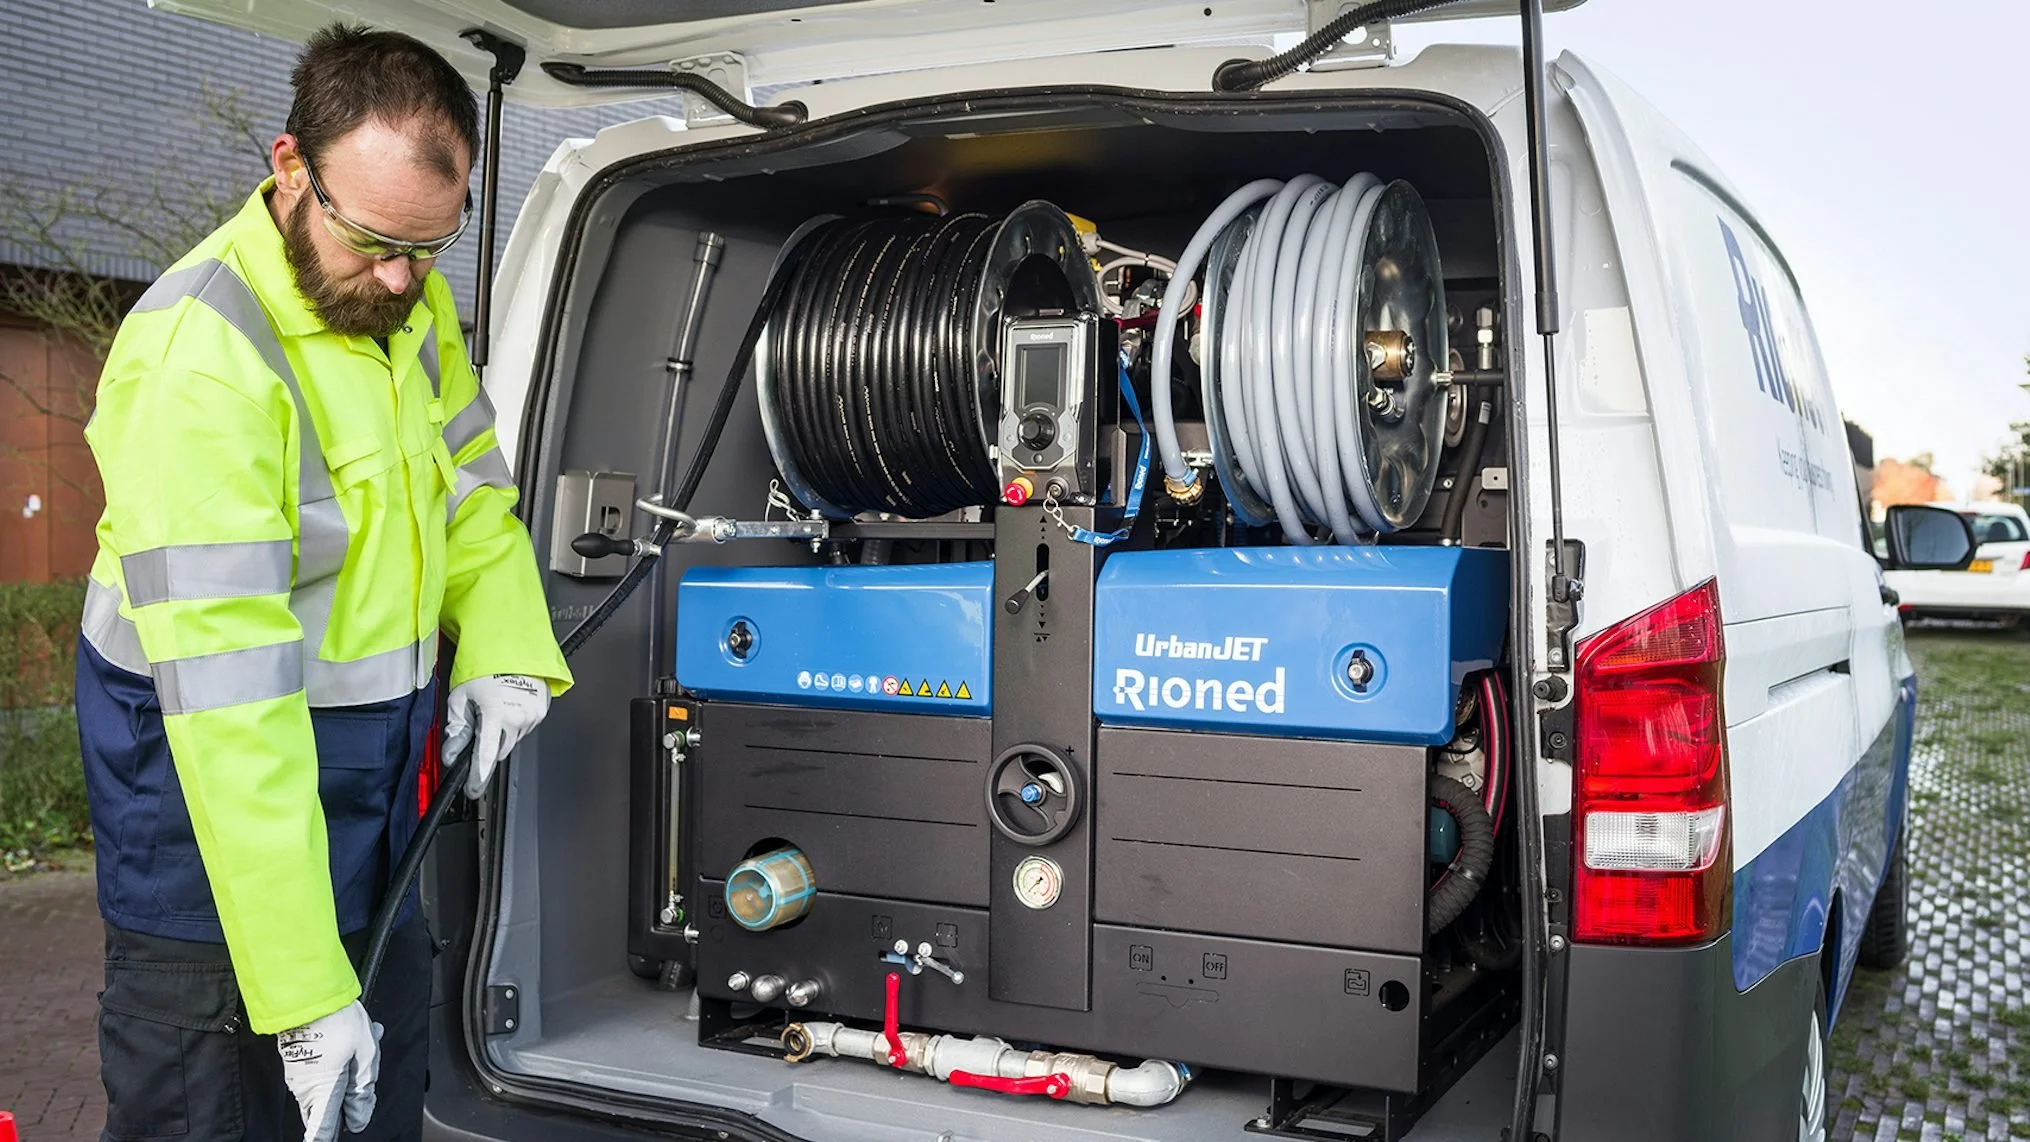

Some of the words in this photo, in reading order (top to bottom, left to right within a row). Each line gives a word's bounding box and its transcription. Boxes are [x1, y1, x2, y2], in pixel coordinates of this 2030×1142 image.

[1135, 632, 1269, 662] UrbanJET
[1112, 666, 1286, 714] Rioned
[1133, 953, 1149, 963] ON
[1206, 962, 1224, 972] OFF
